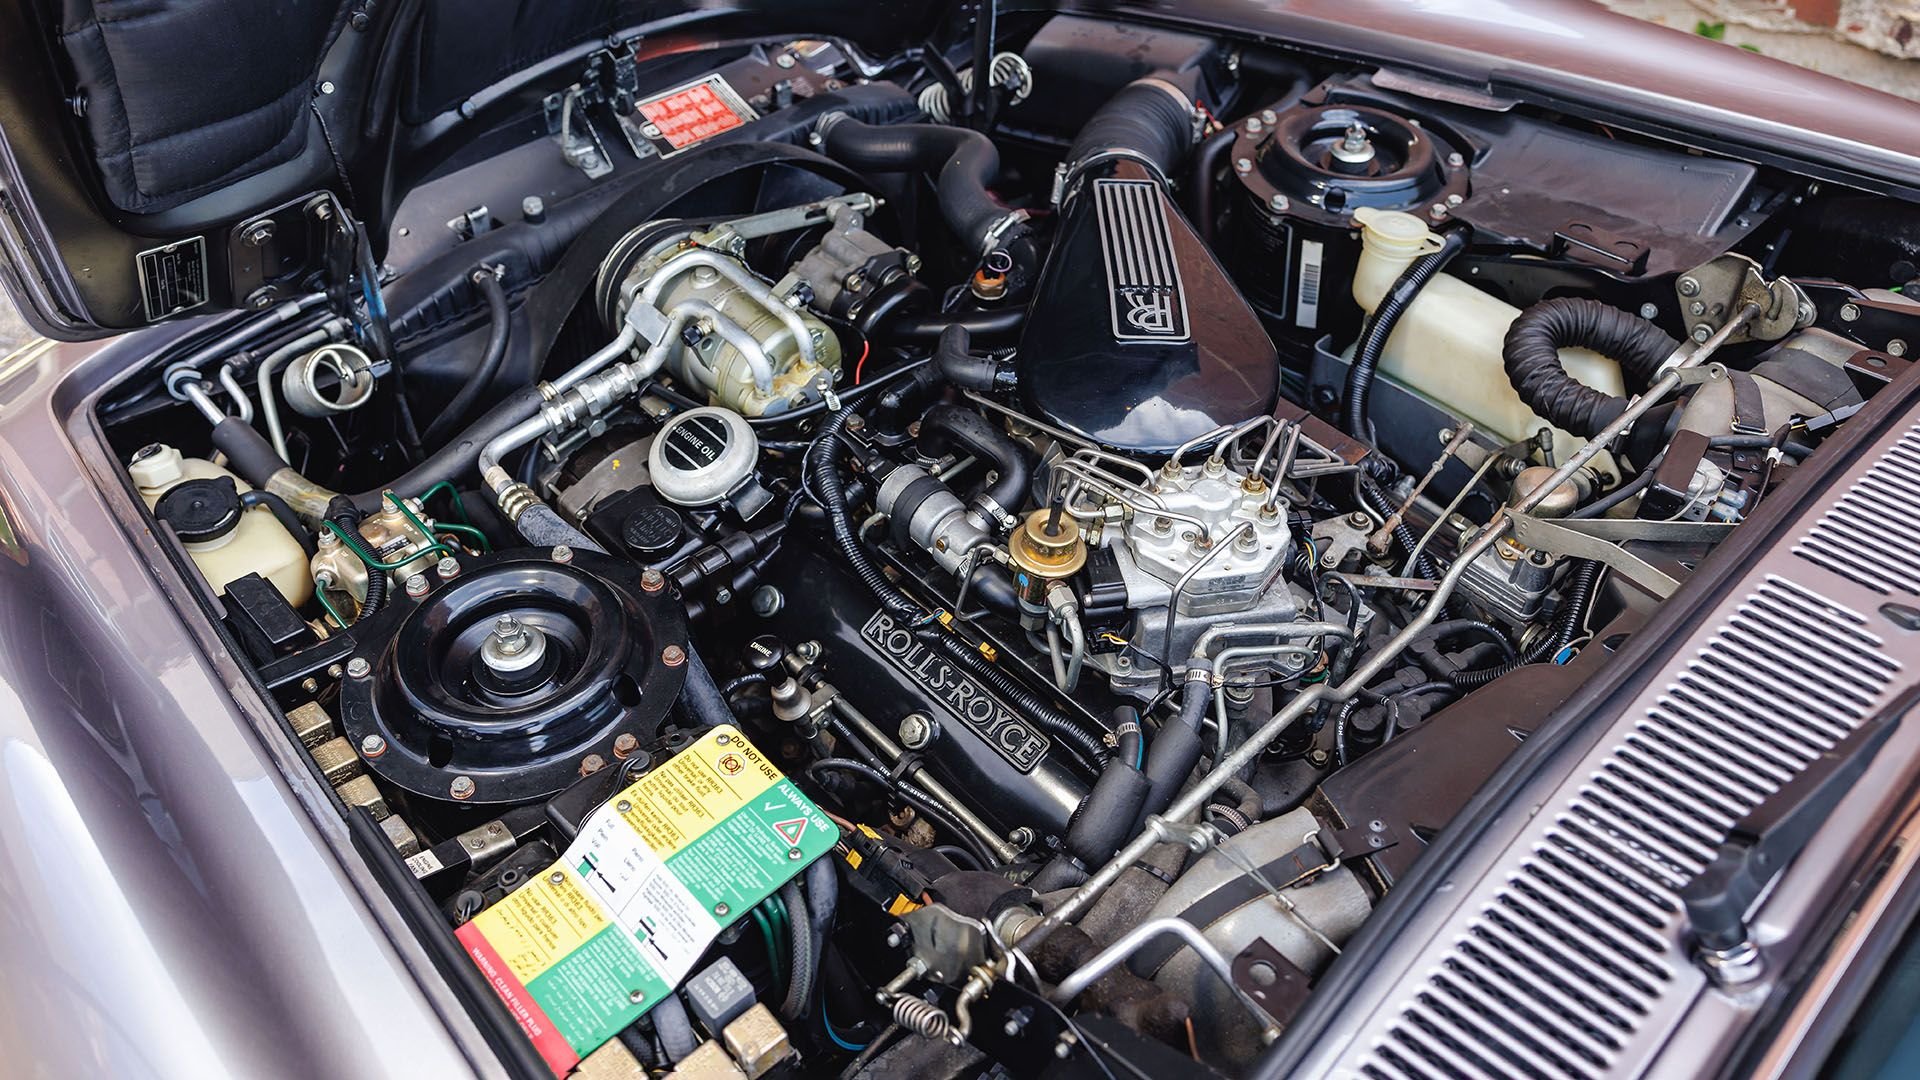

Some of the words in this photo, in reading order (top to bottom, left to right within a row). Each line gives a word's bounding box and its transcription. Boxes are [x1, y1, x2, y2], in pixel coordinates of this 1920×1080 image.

[676, 426, 702, 449] ENGINE
[700, 445, 716, 460] OIL
[750, 640, 771, 658] ENGINE
[863, 614, 1046, 764] ROLLS-ROYCE
[731, 735, 744, 748] DO
[743, 747, 761, 765] NOT
[759, 763, 776, 780] USE
[779, 782, 811, 816] ALWAYS
[809, 813, 829, 833] USE
[495, 976, 514, 998] CLEAN
[509, 996, 529, 1019] FILLER
[525, 1017, 542, 1036] PLUG
